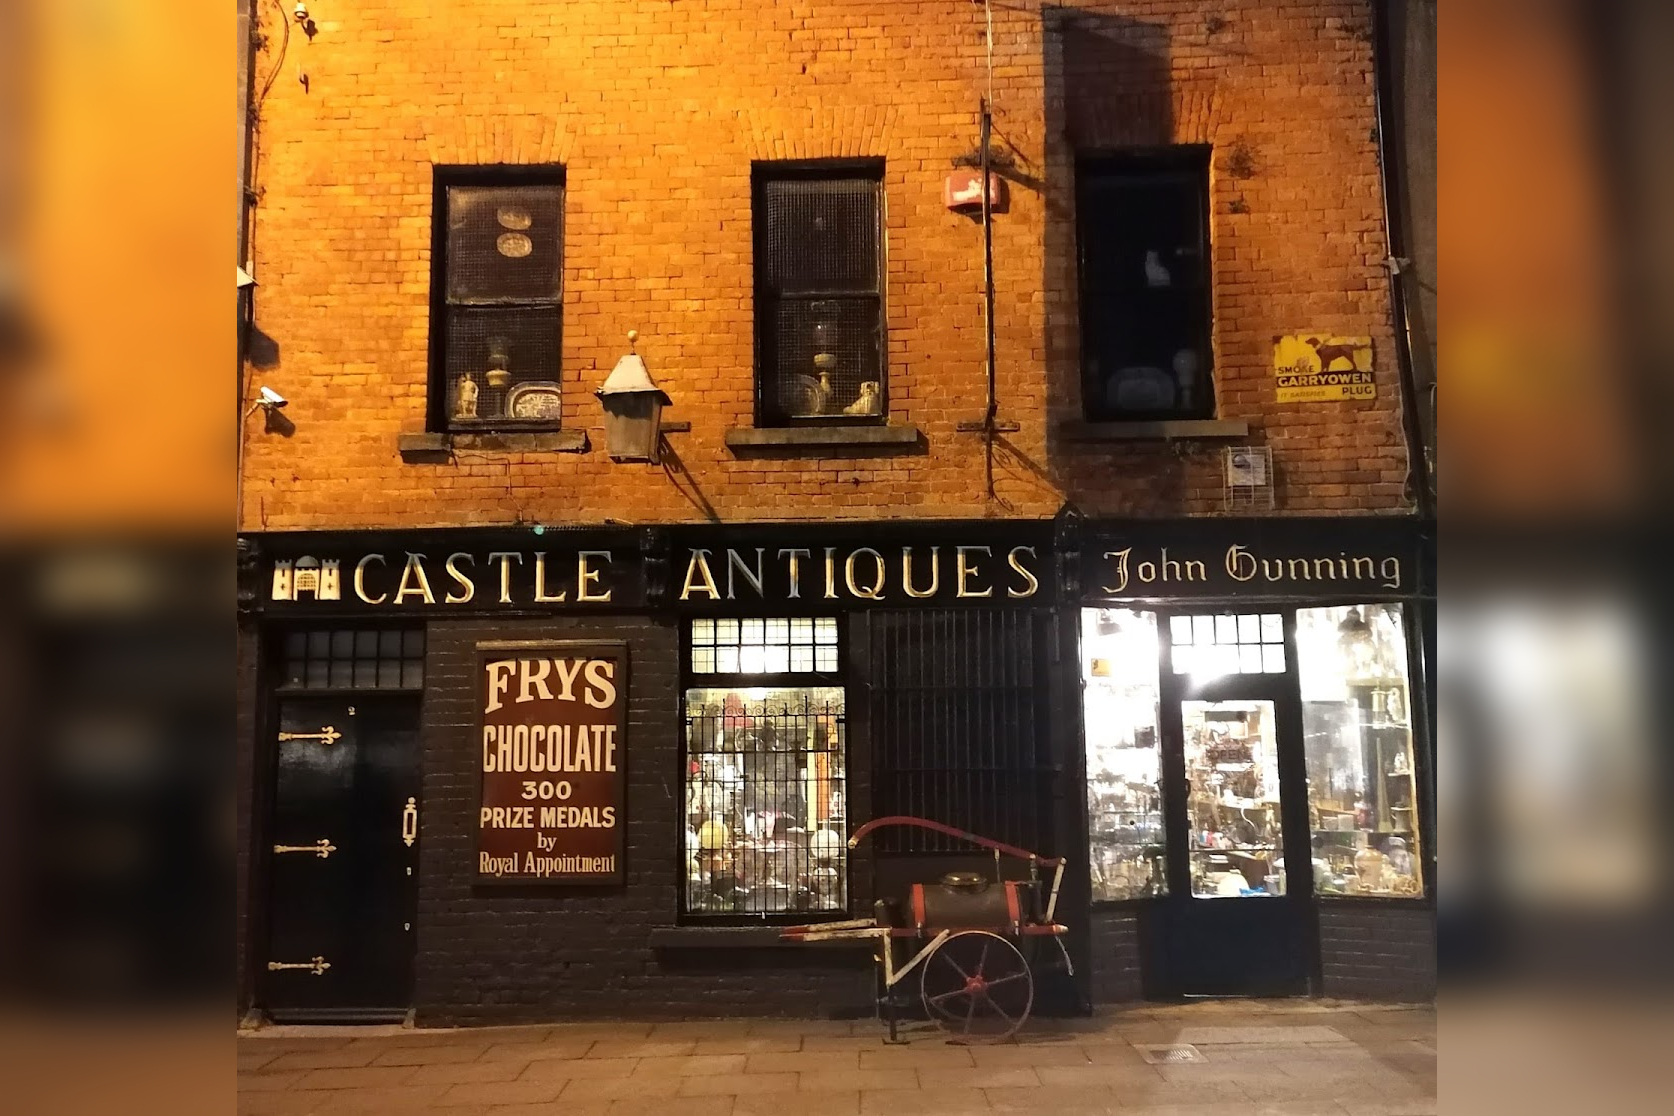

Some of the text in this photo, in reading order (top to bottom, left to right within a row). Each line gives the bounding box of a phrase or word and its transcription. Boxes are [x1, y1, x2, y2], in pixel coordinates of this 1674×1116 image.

[1278, 365, 1314, 375] SMOKE
[1278, 373, 1372, 387] GARRYOWEN
[1342, 385, 1372, 396] PLUG
[353, 545, 1039, 605] CASTLE ANTIQUES
[1102, 543, 1400, 594] John Gunning
[484, 658, 617, 715] FRYS
[483, 724, 617, 773] CHOCOLATE
[521, 780, 572, 800] 300
[480, 806, 616, 829] PRIZE MEDALS
[537, 831, 557, 852] by
[479, 851, 615, 878] Royal Appointment
